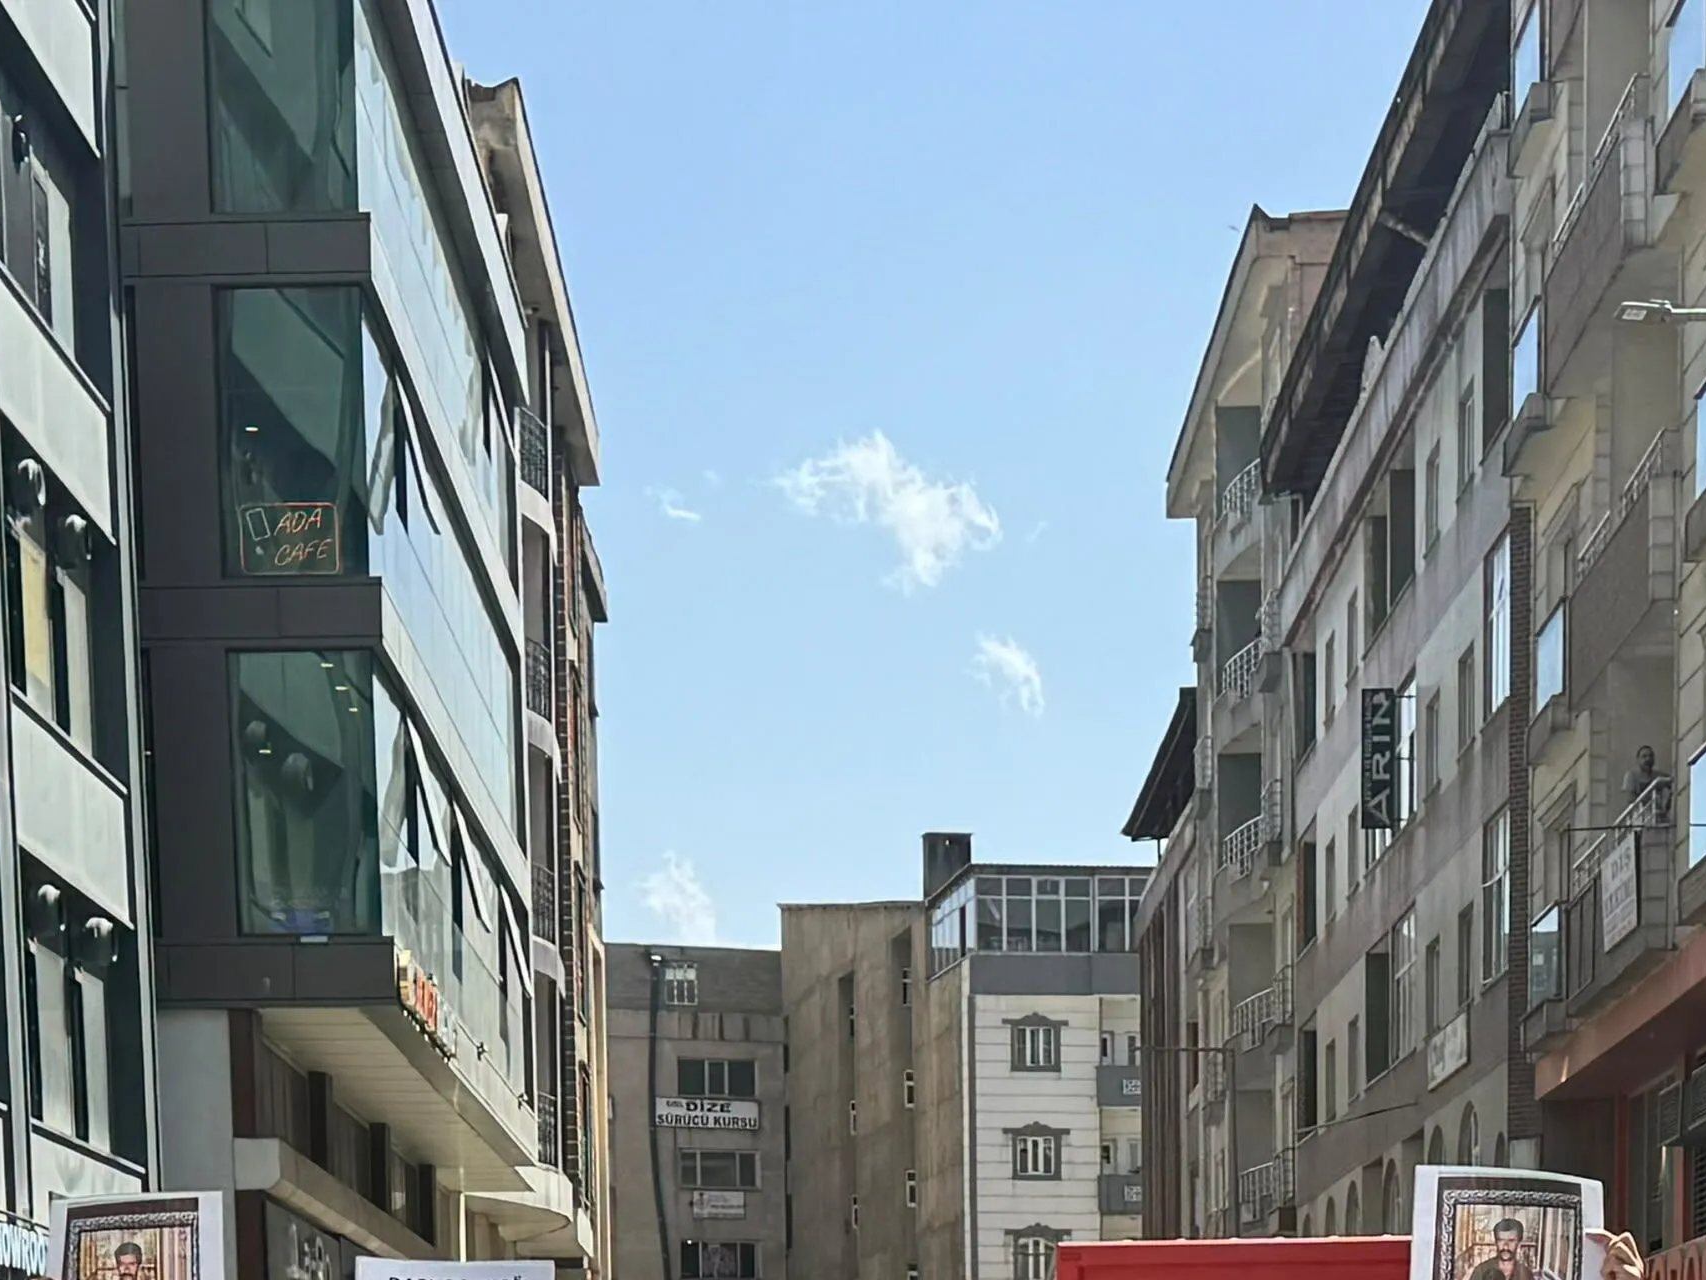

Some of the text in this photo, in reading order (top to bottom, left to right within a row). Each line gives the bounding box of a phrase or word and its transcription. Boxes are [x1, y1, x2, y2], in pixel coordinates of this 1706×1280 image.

[273, 507, 322, 536] ADA
[274, 538, 334, 566] CAFE
[656, 1112, 758, 1129] SÜRÜCÜ KURSU
